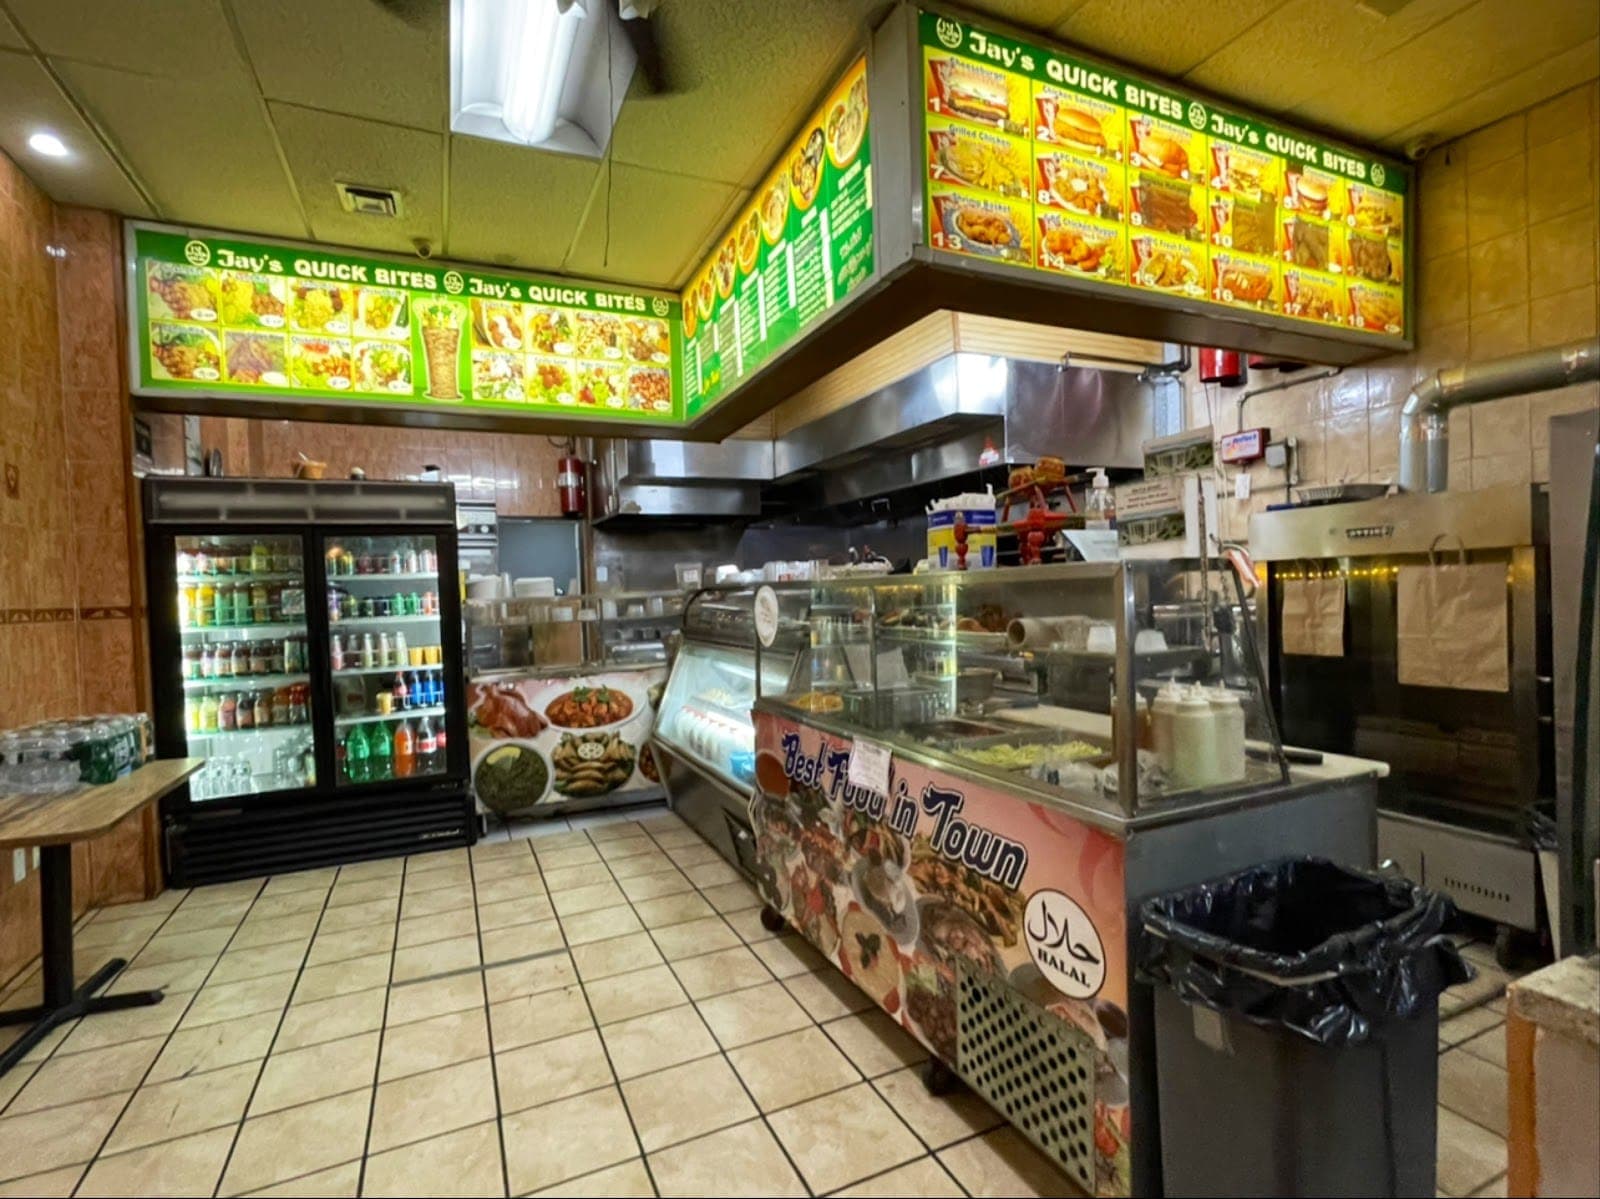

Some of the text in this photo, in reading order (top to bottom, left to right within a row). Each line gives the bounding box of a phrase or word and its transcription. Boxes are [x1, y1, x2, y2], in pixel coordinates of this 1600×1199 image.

[969, 31, 1035, 71] Jay's
[1046, 60, 1118, 99] QUICK
[1125, 84, 1183, 120] BITES
[1211, 113, 1260, 144] Jay's
[1265, 132, 1317, 163] QUICK
[1323, 151, 1366, 179] BITES
[1038, 190, 1051, 205] 8
[216, 249, 283, 273] Jay's
[294, 259, 368, 282] QUICK
[374, 268, 437, 290] BITES
[468, 278, 522, 298] Jay's
[528, 285, 588, 306] QUICK
[595, 293, 646, 312] BITES
[782, 733, 827, 789] Best
[889, 779, 919, 838] in
[922, 783, 1027, 889] Town
[1028, 900, 1099, 964] حلال
[1038, 948, 1090, 989] HALAL
